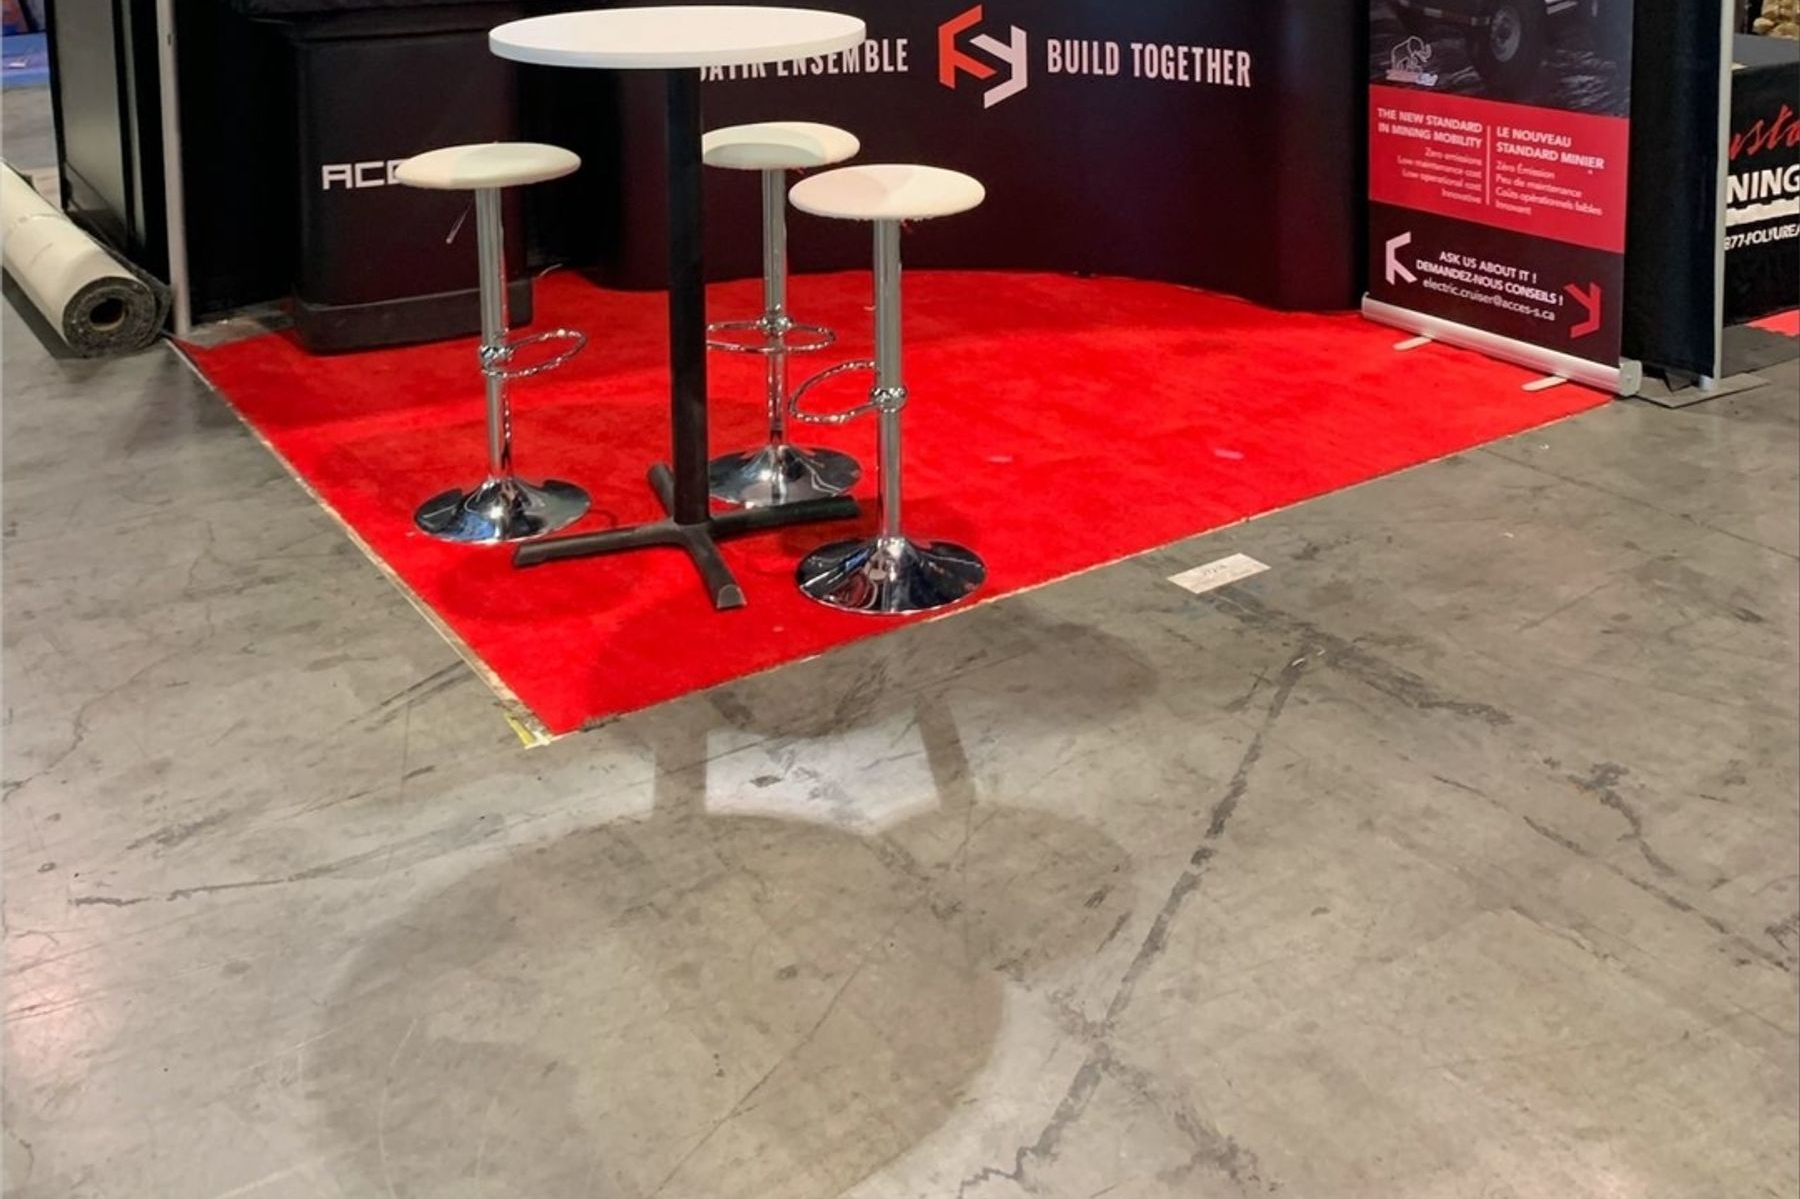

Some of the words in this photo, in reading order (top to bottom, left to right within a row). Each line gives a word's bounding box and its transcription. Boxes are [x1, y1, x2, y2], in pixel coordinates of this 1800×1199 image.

[1047, 39, 1120, 76] BUILD
[1130, 42, 1251, 88] TOGETHER
[1377, 108, 1397, 120] THE
[1399, 111, 1424, 124] NEW
[1426, 114, 1482, 133] STANDARD
[1378, 122, 1390, 133] IN
[1392, 125, 1431, 140] MINING
[1433, 131, 1482, 148] MOBILITY
[1497, 126, 1510, 138] LE
[1512, 129, 1572, 148] NOUVEAU
[1496, 142, 1559, 161] STANDARD
[1560, 152, 1605, 170] MINIER
[1439, 251, 1461, 266] ASK
[1462, 256, 1477, 269] US
[1479, 261, 1517, 279] ABOUT
[1518, 270, 1530, 282] IT
[1416, 259, 1503, 290] DEMANDEZ-NOUS
[1505, 282, 1557, 304] CONSEILS
